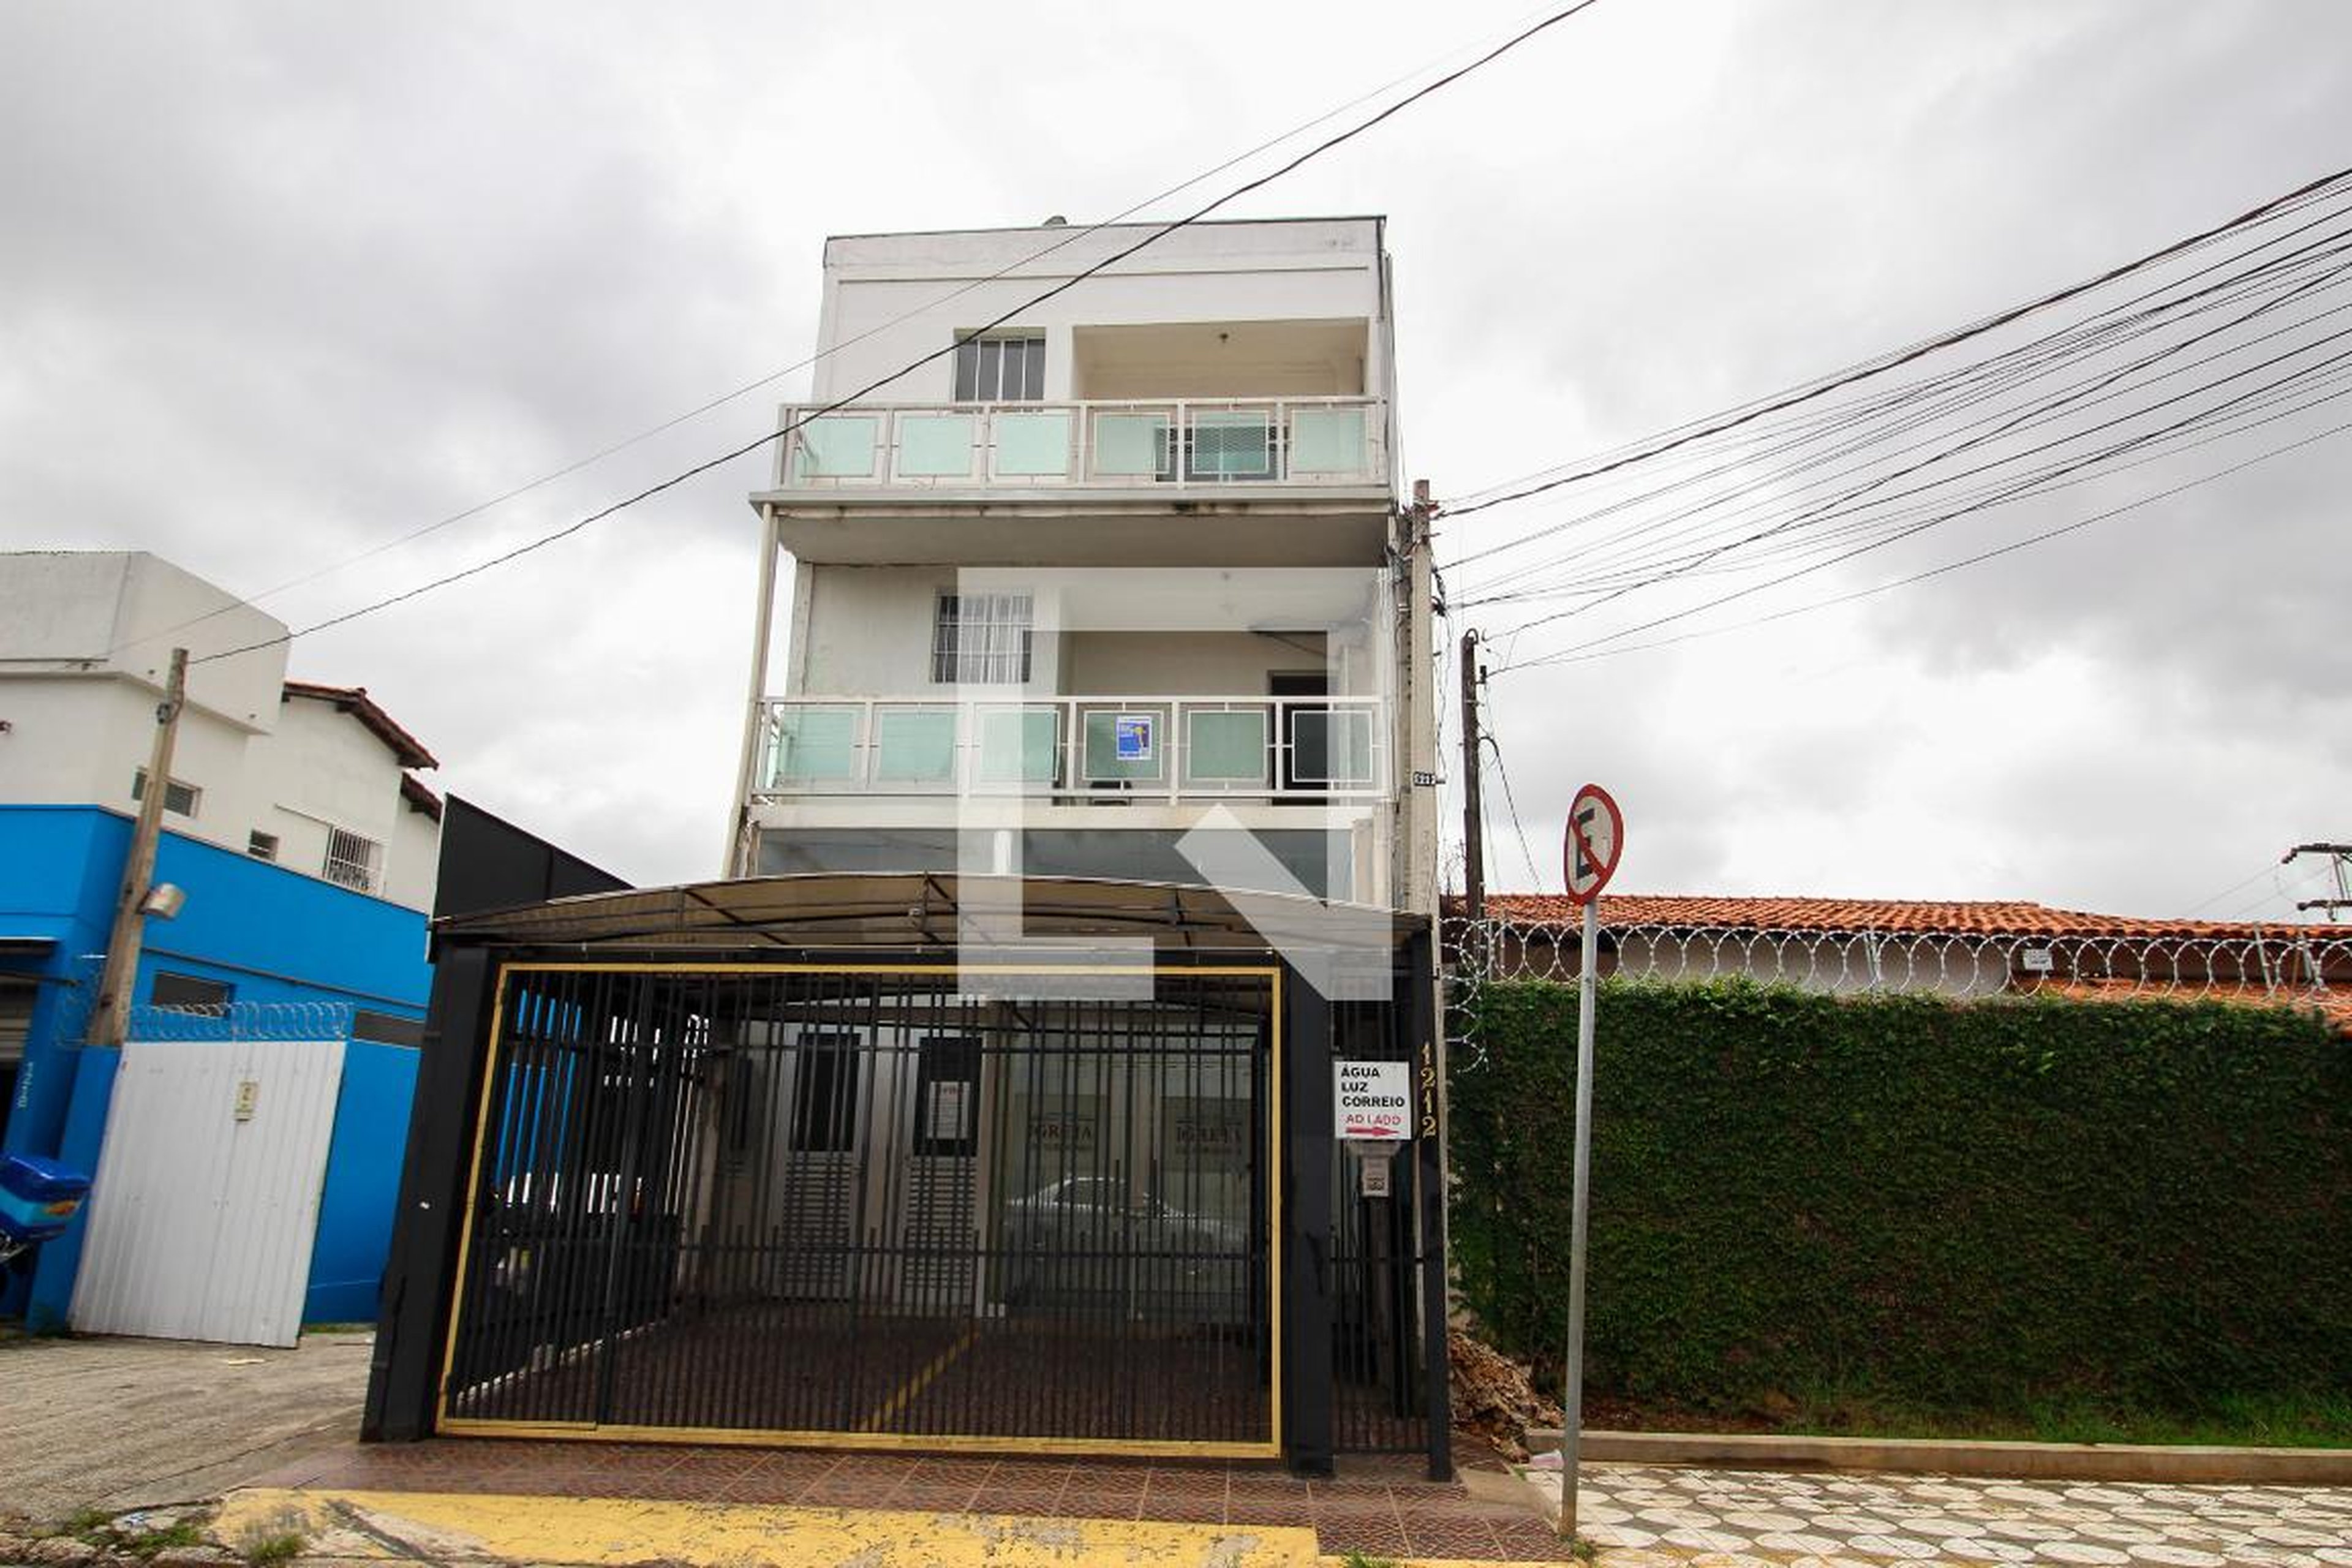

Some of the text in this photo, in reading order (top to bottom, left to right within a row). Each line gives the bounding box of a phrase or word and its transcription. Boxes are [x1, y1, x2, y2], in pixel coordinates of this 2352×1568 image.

[1341, 1082, 1368, 1093] LUZ
[1419, 1042, 1436, 1137] 1212
[1342, 1096, 1405, 1107] CORREIO
